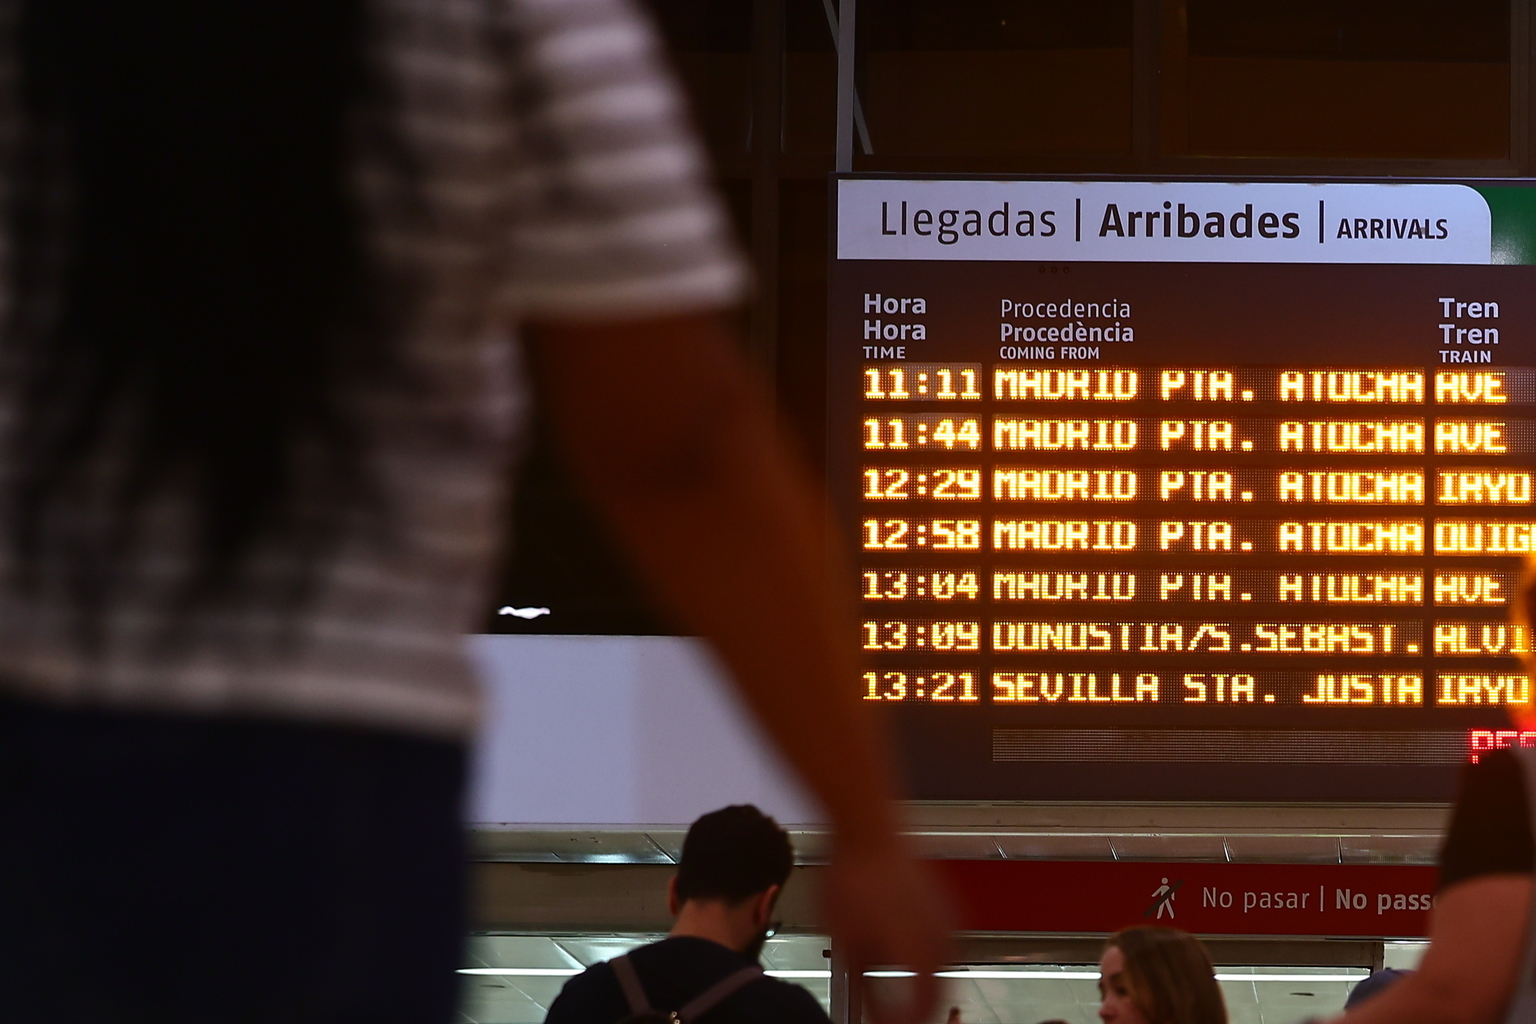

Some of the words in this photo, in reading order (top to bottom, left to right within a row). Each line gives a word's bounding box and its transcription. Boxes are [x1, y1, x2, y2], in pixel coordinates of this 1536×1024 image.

[881, 200, 1056, 245] Llegadas
[1098, 200, 1300, 239] Arribades
[1336, 218, 1448, 240] ARRIVALS
[864, 293, 926, 314] Hora
[1001, 298, 1130, 318] Procedencia
[1438, 297, 1499, 319] Tren
[864, 319, 926, 340] Hora
[1001, 321, 1134, 342] Procedència
[1438, 323, 1499, 345] Tren
[862, 346, 906, 359] TIME
[999, 346, 1055, 360] COMING
[1061, 346, 1099, 360] FROM
[1438, 350, 1491, 363] TRAIN
[865, 368, 981, 400] 11:11
[994, 368, 1138, 401] MADRID
[1160, 370, 1254, 402] PTA.
[1279, 370, 1425, 403] ATOCHA
[1434, 371, 1507, 403] AVE
[864, 418, 981, 450] 11:44
[993, 419, 1138, 451] MADRID
[1160, 420, 1254, 452] PTA.
[1279, 421, 1425, 453] ATOCHA
[1434, 421, 1507, 454] AVE
[864, 468, 981, 501] 12:29
[993, 469, 1137, 501] MADRID
[1160, 470, 1253, 502] PTA.
[1278, 470, 1425, 504] ATOCHA
[1438, 472, 1532, 504] IRYO
[863, 519, 980, 550] 12:58
[993, 520, 1137, 551] MADRID
[1159, 521, 1253, 551] PTA.
[1278, 520, 1425, 553] ATOCHA
[863, 570, 979, 599] 13:04
[993, 571, 1136, 600] MADRID
[1160, 572, 1252, 601] PTA.
[1279, 573, 1423, 602] ATOCHA
[1433, 574, 1506, 603] AVE
[863, 621, 979, 650] 13:09
[1434, 624, 1536, 654] ALVI
[862, 671, 979, 701] 13:21
[992, 672, 1159, 702] SEVILLA
[1183, 673, 1275, 702] STA.
[1302, 674, 1423, 703] JUSTA
[1437, 674, 1532, 706] IRYO
[1203, 886, 1233, 908] No
[1244, 892, 1310, 913] pasar
[1336, 888, 1367, 910] No
